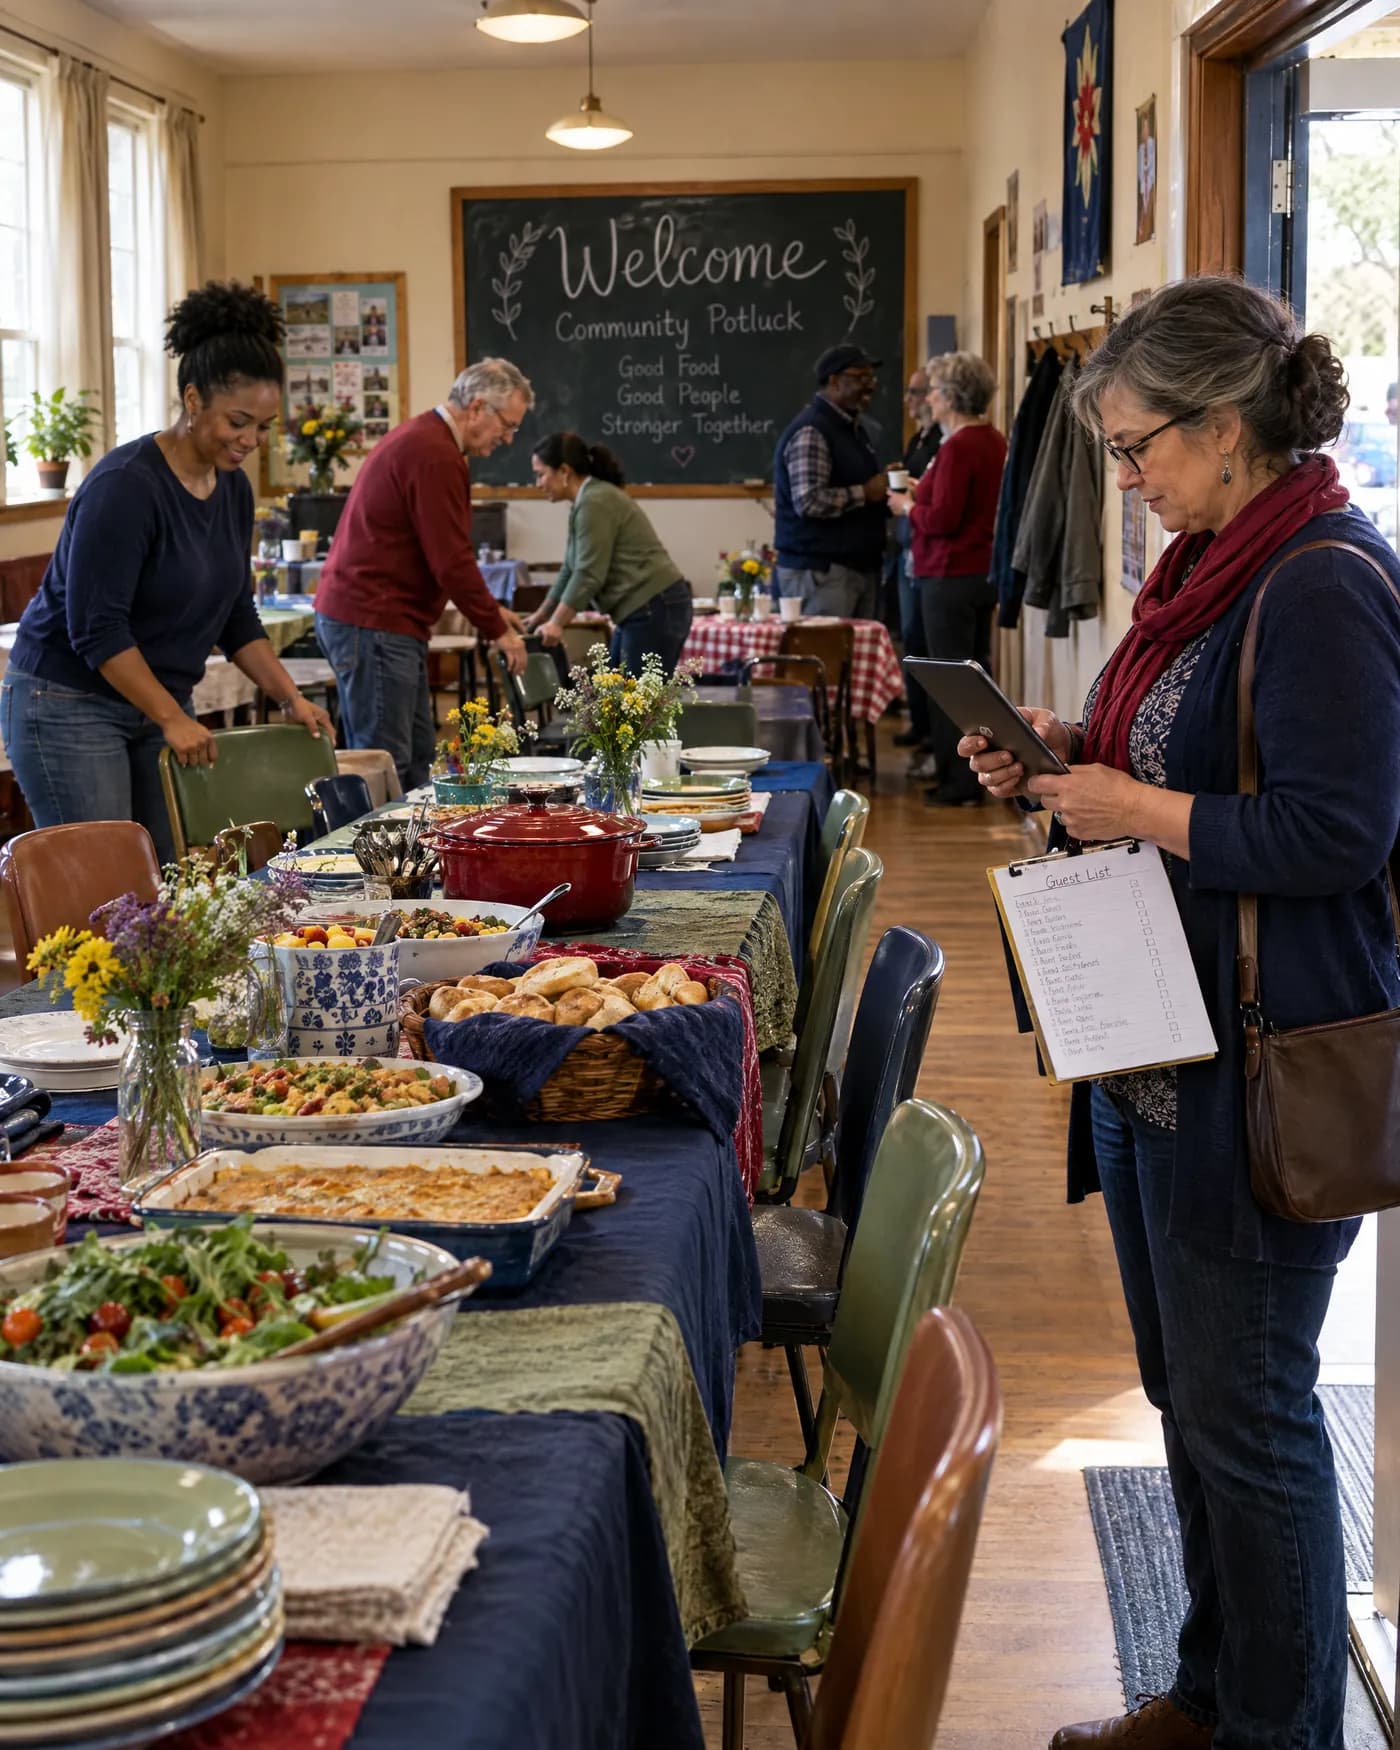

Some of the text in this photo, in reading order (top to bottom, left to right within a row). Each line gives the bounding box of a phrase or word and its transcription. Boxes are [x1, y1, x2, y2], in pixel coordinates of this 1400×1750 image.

[549, 215, 827, 298] Welcome
[556, 302, 804, 350] Community Potluck
[618, 354, 720, 377] Good Food
[617, 383, 741, 411] Good People
[601, 413, 773, 443] Stronger Together
[1045, 866, 1112, 890] Guest List
